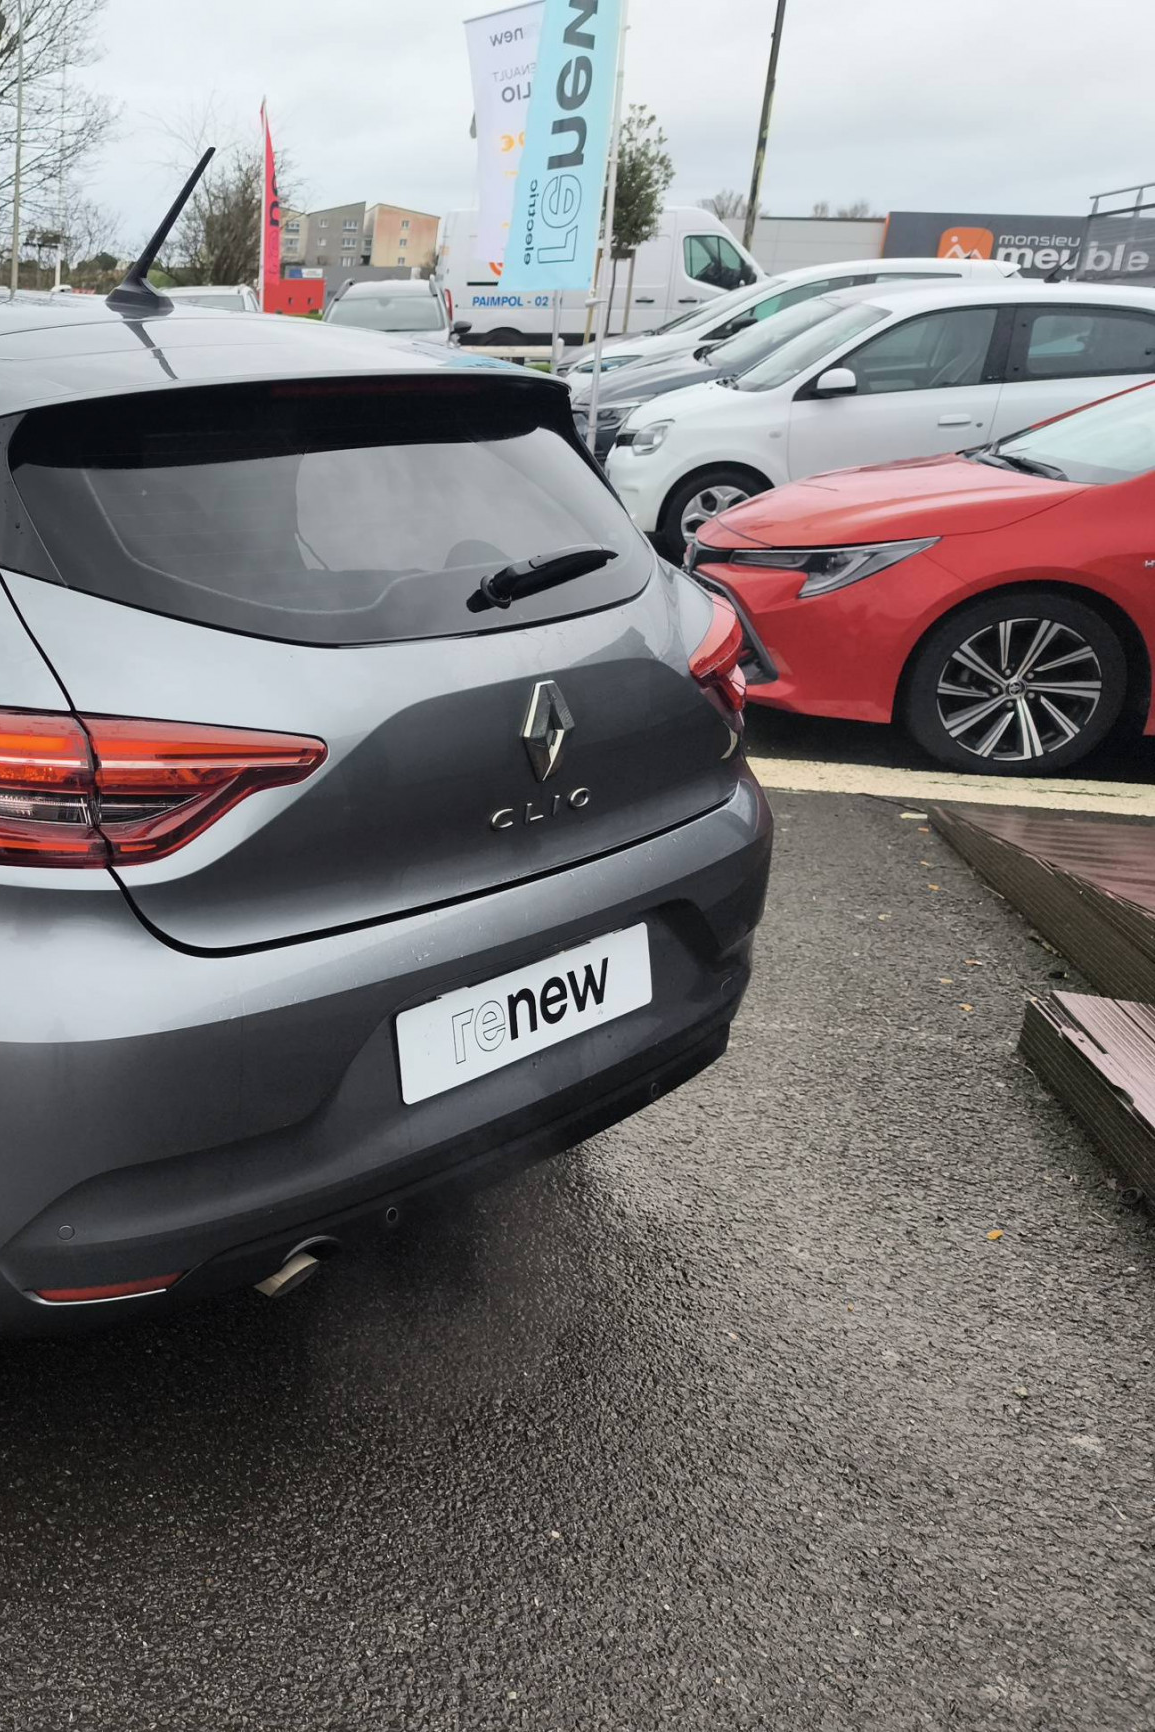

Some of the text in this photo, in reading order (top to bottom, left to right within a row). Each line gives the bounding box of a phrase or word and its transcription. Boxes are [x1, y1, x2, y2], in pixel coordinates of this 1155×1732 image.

[999, 234, 1082, 247] monsieu
[996, 241, 1150, 272] meuble
[472, 296, 524, 307] PAIMPOL
[534, 296, 549, 307] 02
[490, 787, 590, 831] CLIO
[451, 957, 609, 1065] renew
